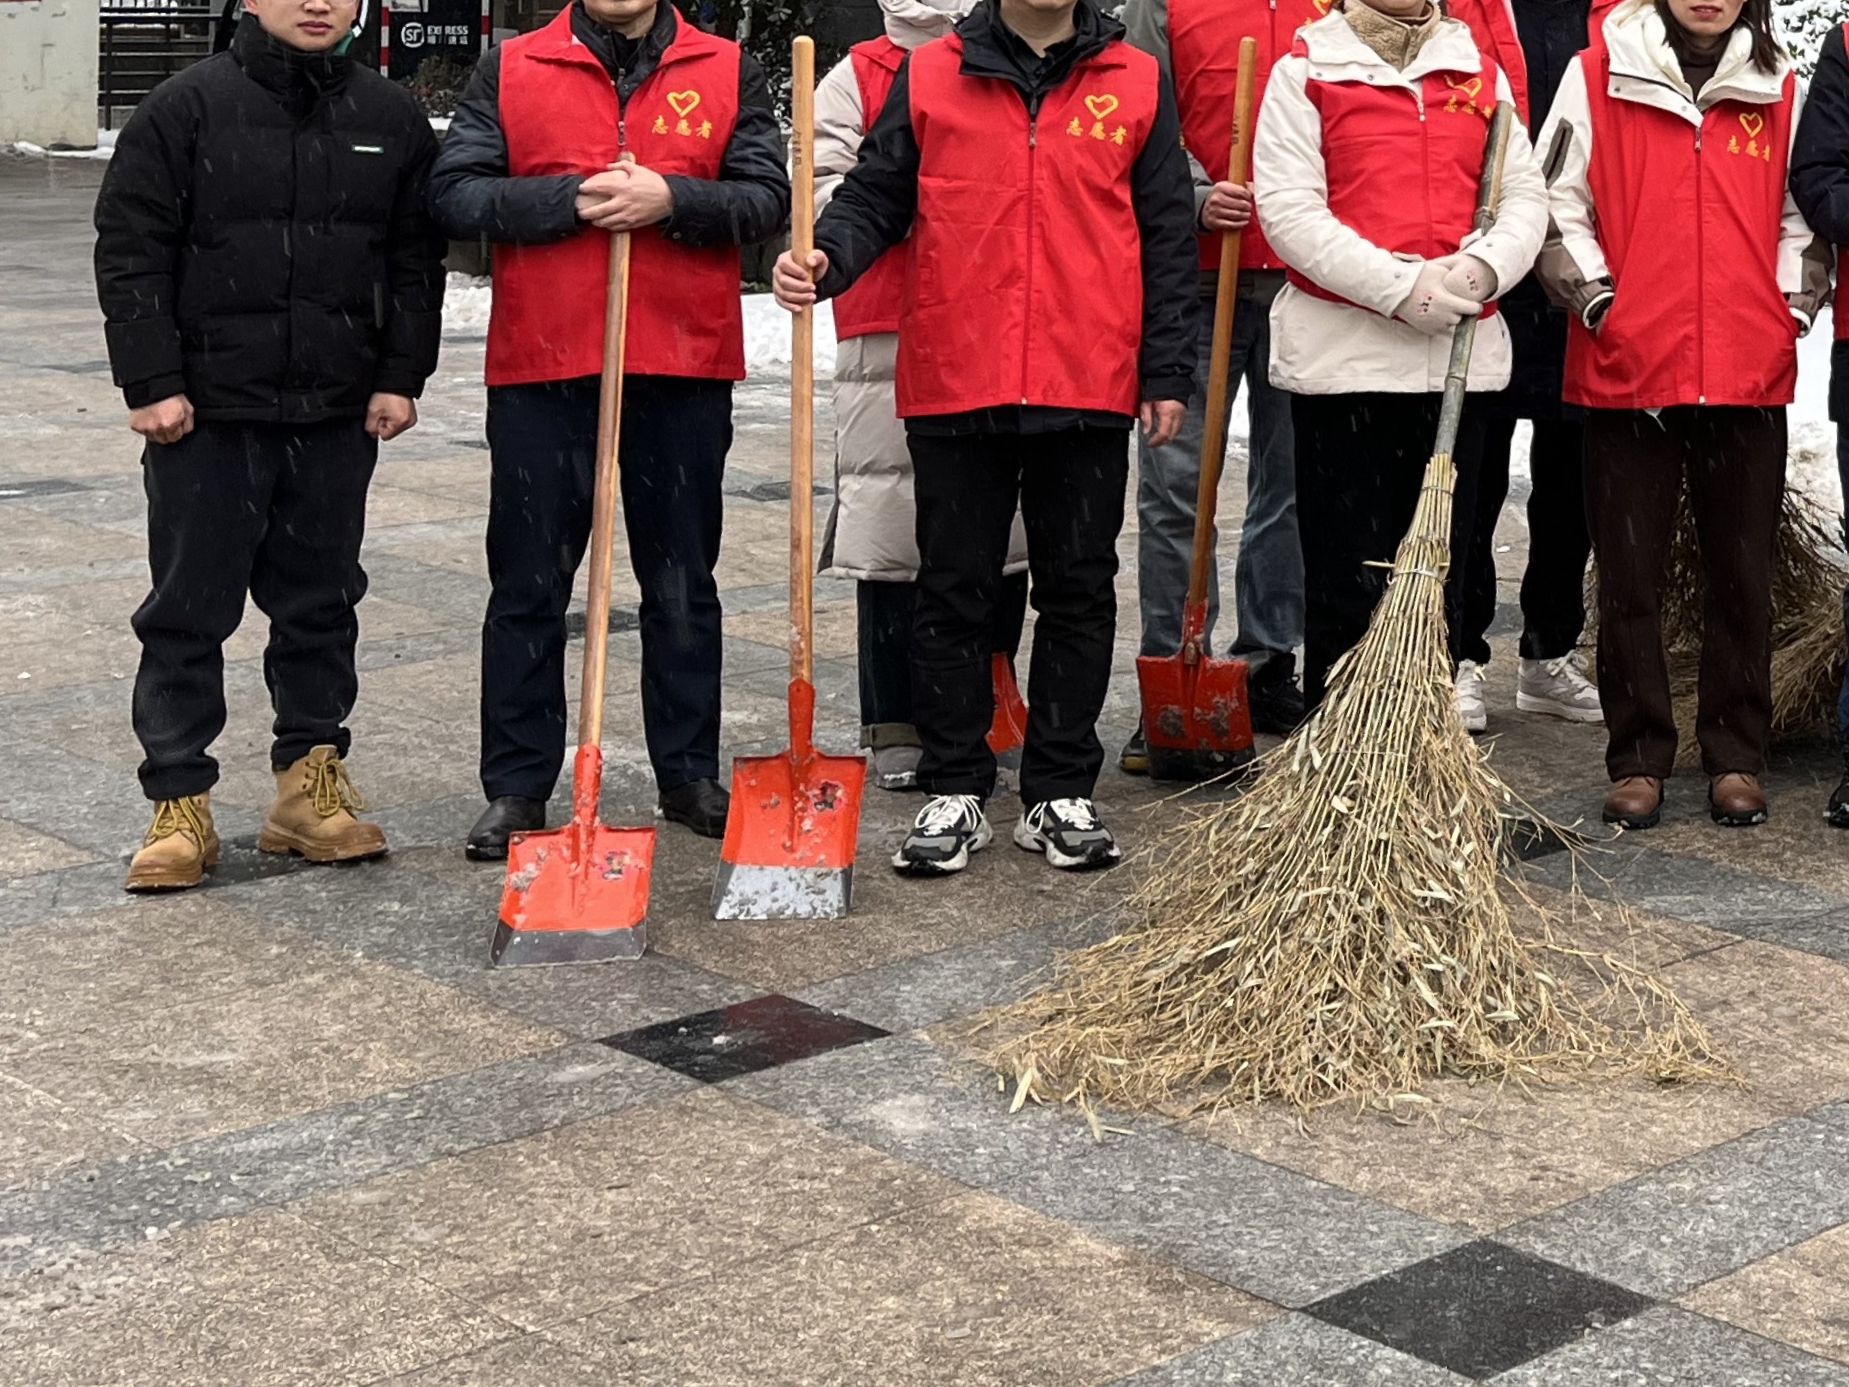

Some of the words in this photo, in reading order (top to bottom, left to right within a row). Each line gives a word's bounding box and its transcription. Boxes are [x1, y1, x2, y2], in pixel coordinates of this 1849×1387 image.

[651, 114, 713, 140] 志愿者
[1065, 116, 1128, 146] 志愿者
